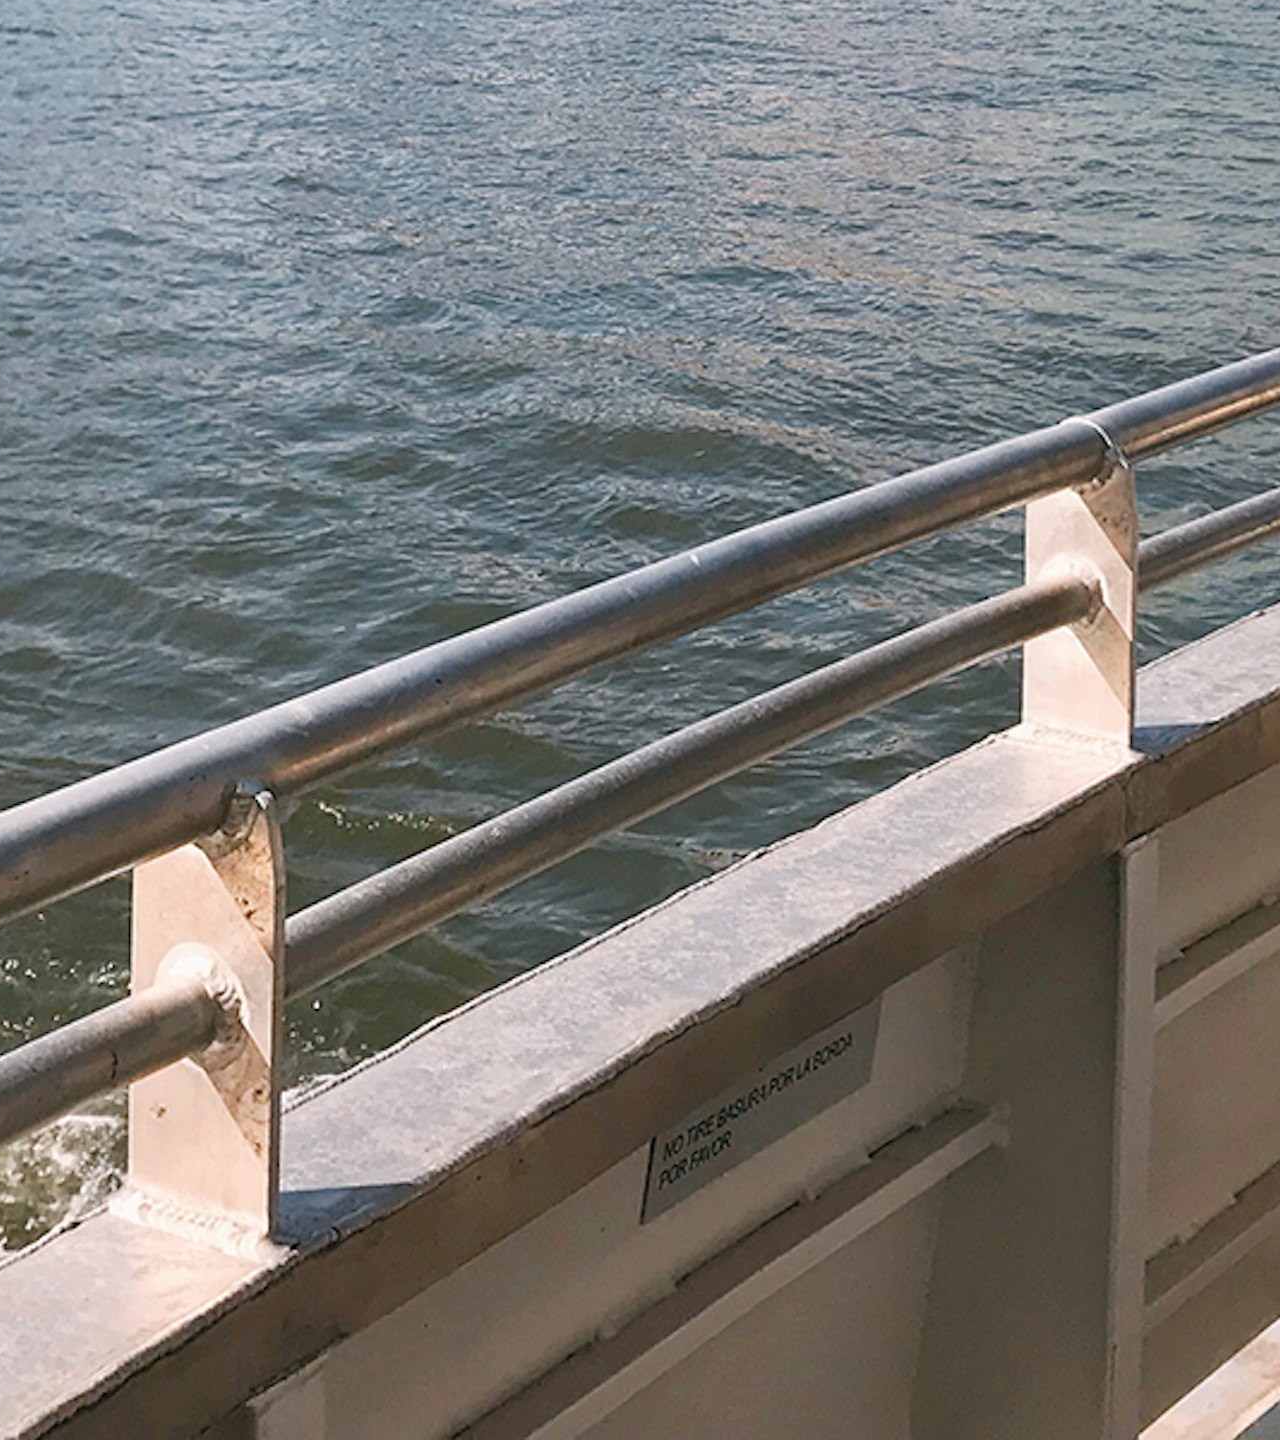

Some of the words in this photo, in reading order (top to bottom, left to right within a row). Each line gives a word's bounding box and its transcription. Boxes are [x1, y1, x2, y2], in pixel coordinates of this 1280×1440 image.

[663, 1135, 684, 1161] NO
[687, 1113, 715, 1145] TIRE
[717, 1084, 767, 1128] BASURA
[769, 1065, 795, 1097] POR
[796, 1057, 811, 1081] LA
[813, 1031, 852, 1072] BORDA
[659, 1158, 688, 1191] POR
[690, 1130, 732, 1172] FAVOR
